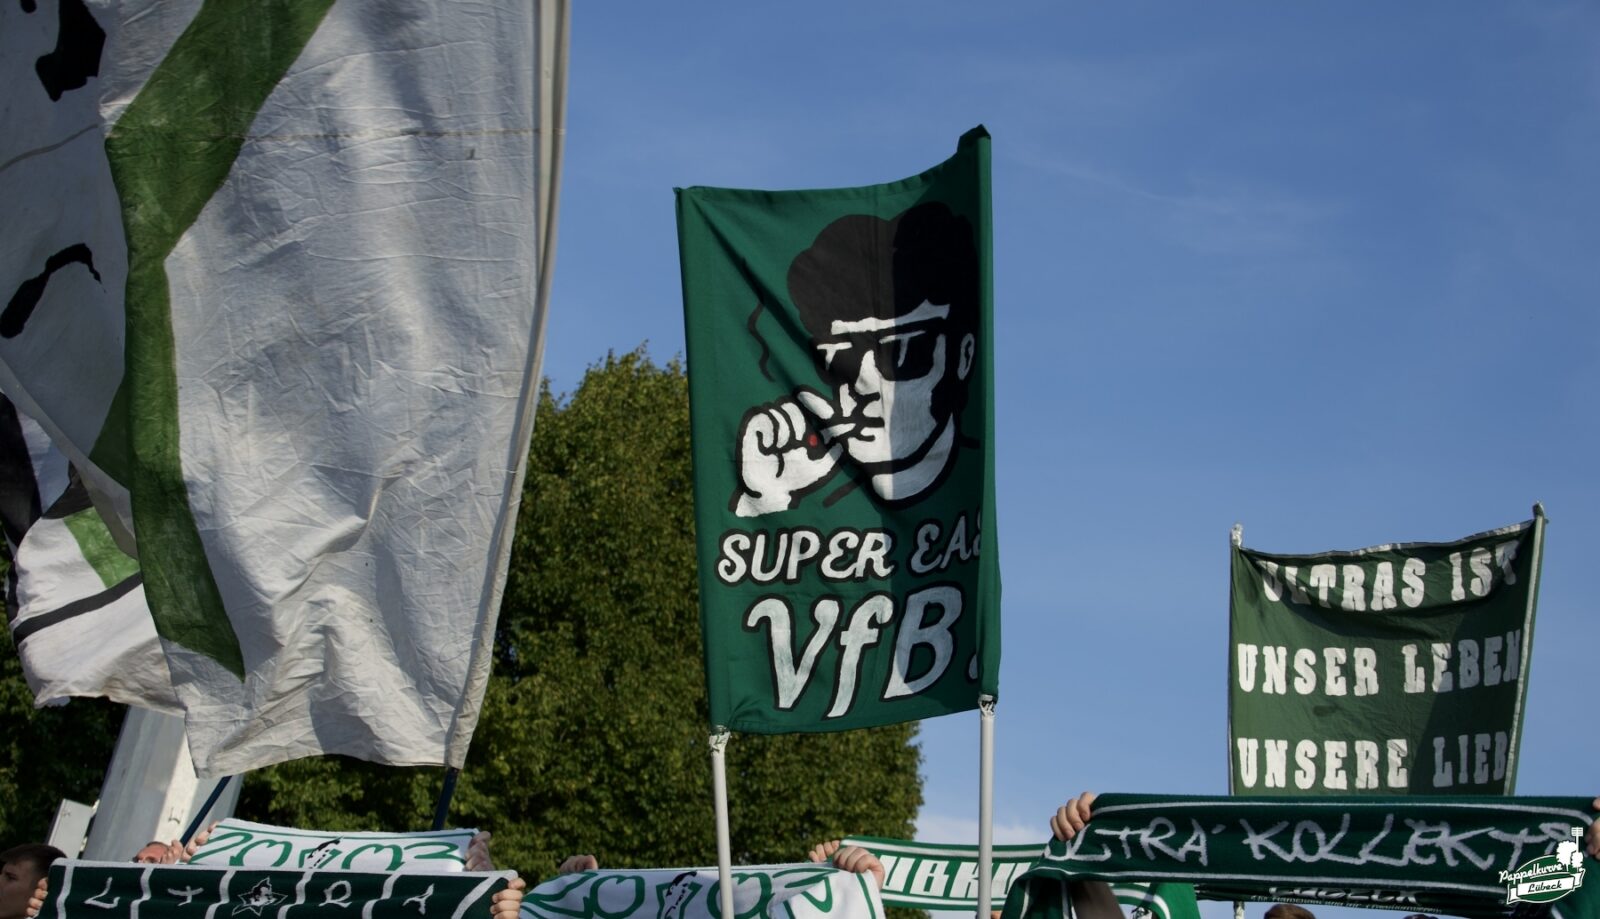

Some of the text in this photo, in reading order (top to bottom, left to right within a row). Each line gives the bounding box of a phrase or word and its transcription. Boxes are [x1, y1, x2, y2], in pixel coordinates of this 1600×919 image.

[716, 530, 896, 584] SUPER
[1256, 540, 1520, 612] ULTRAS IST
[746, 585, 963, 718] VfB
[1237, 629, 1521, 697] UNSER LEBEN
[1237, 737, 1408, 790] UNSERE
